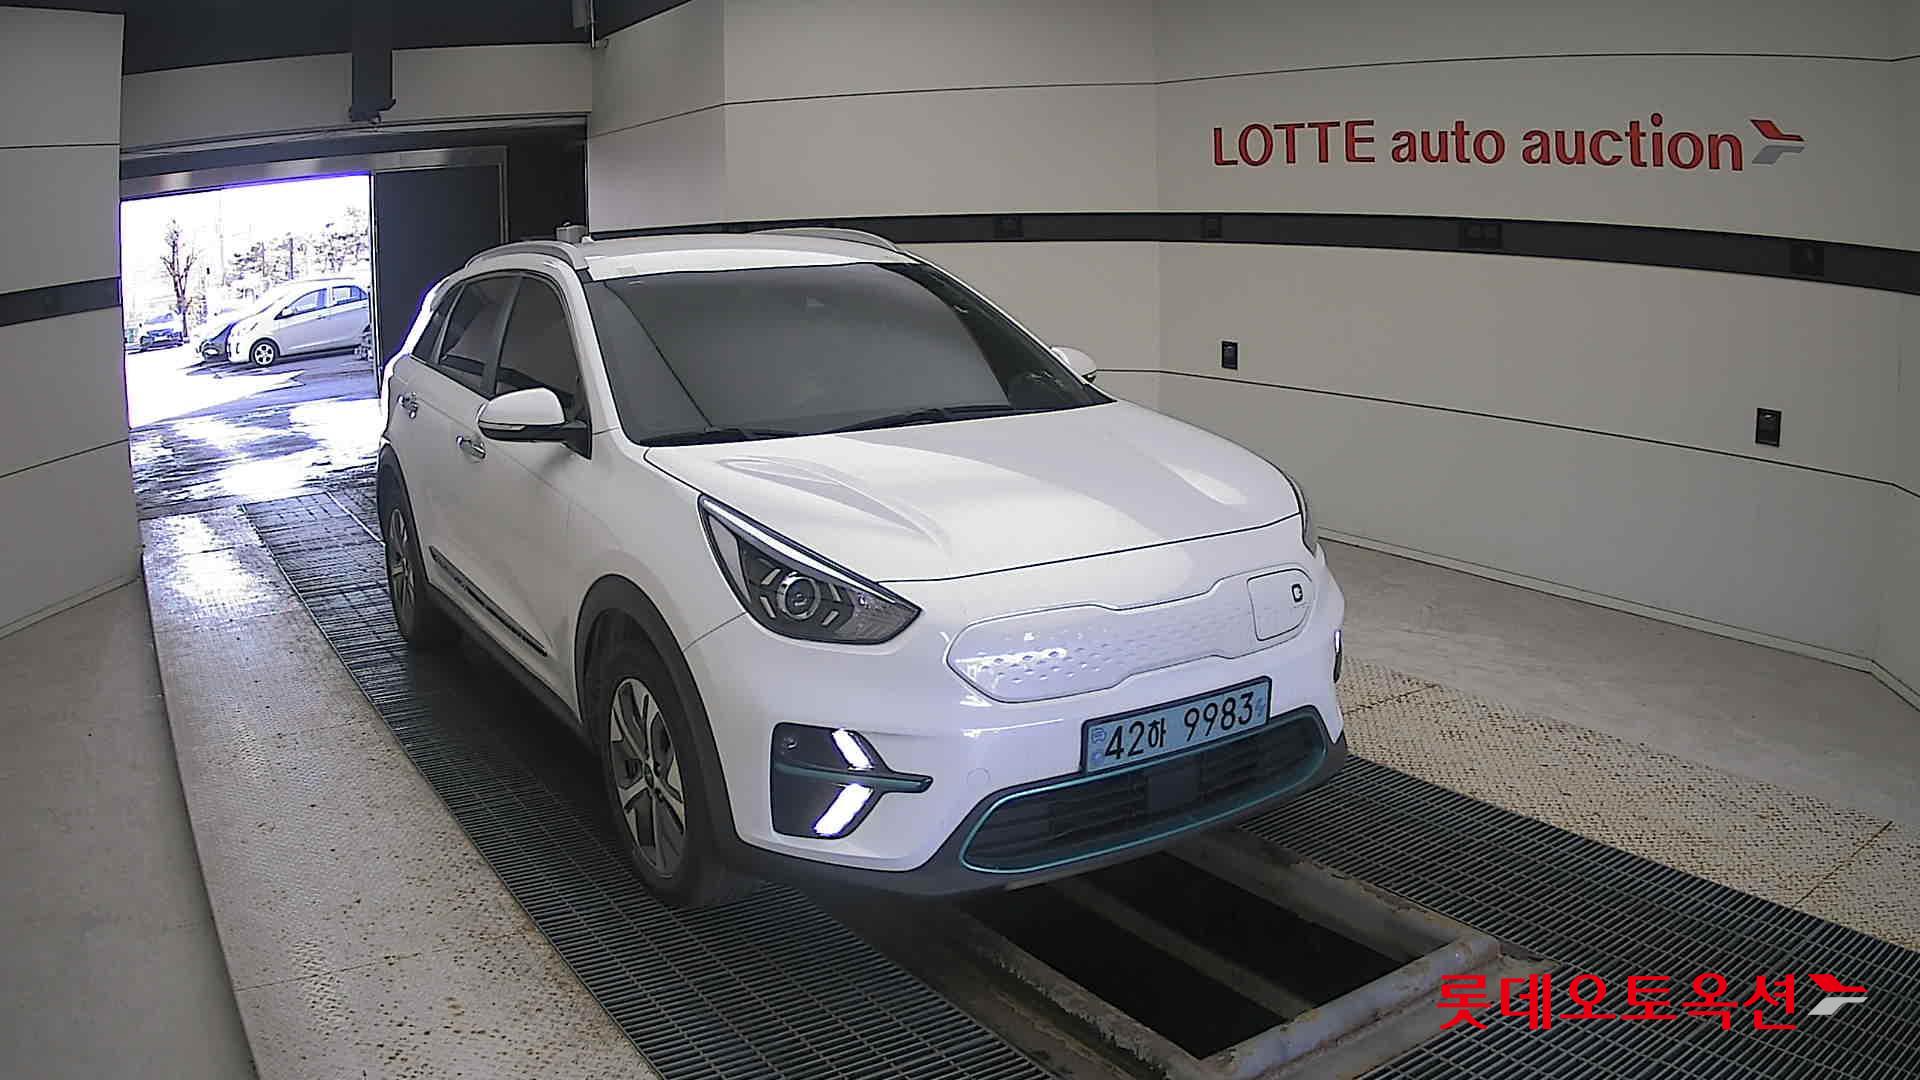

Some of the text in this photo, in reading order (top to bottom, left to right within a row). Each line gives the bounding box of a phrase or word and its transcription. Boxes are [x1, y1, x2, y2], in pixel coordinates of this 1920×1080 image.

[1213, 113, 1744, 171] LOTTE auto auction
[1104, 691, 1254, 760] 42하 9983
